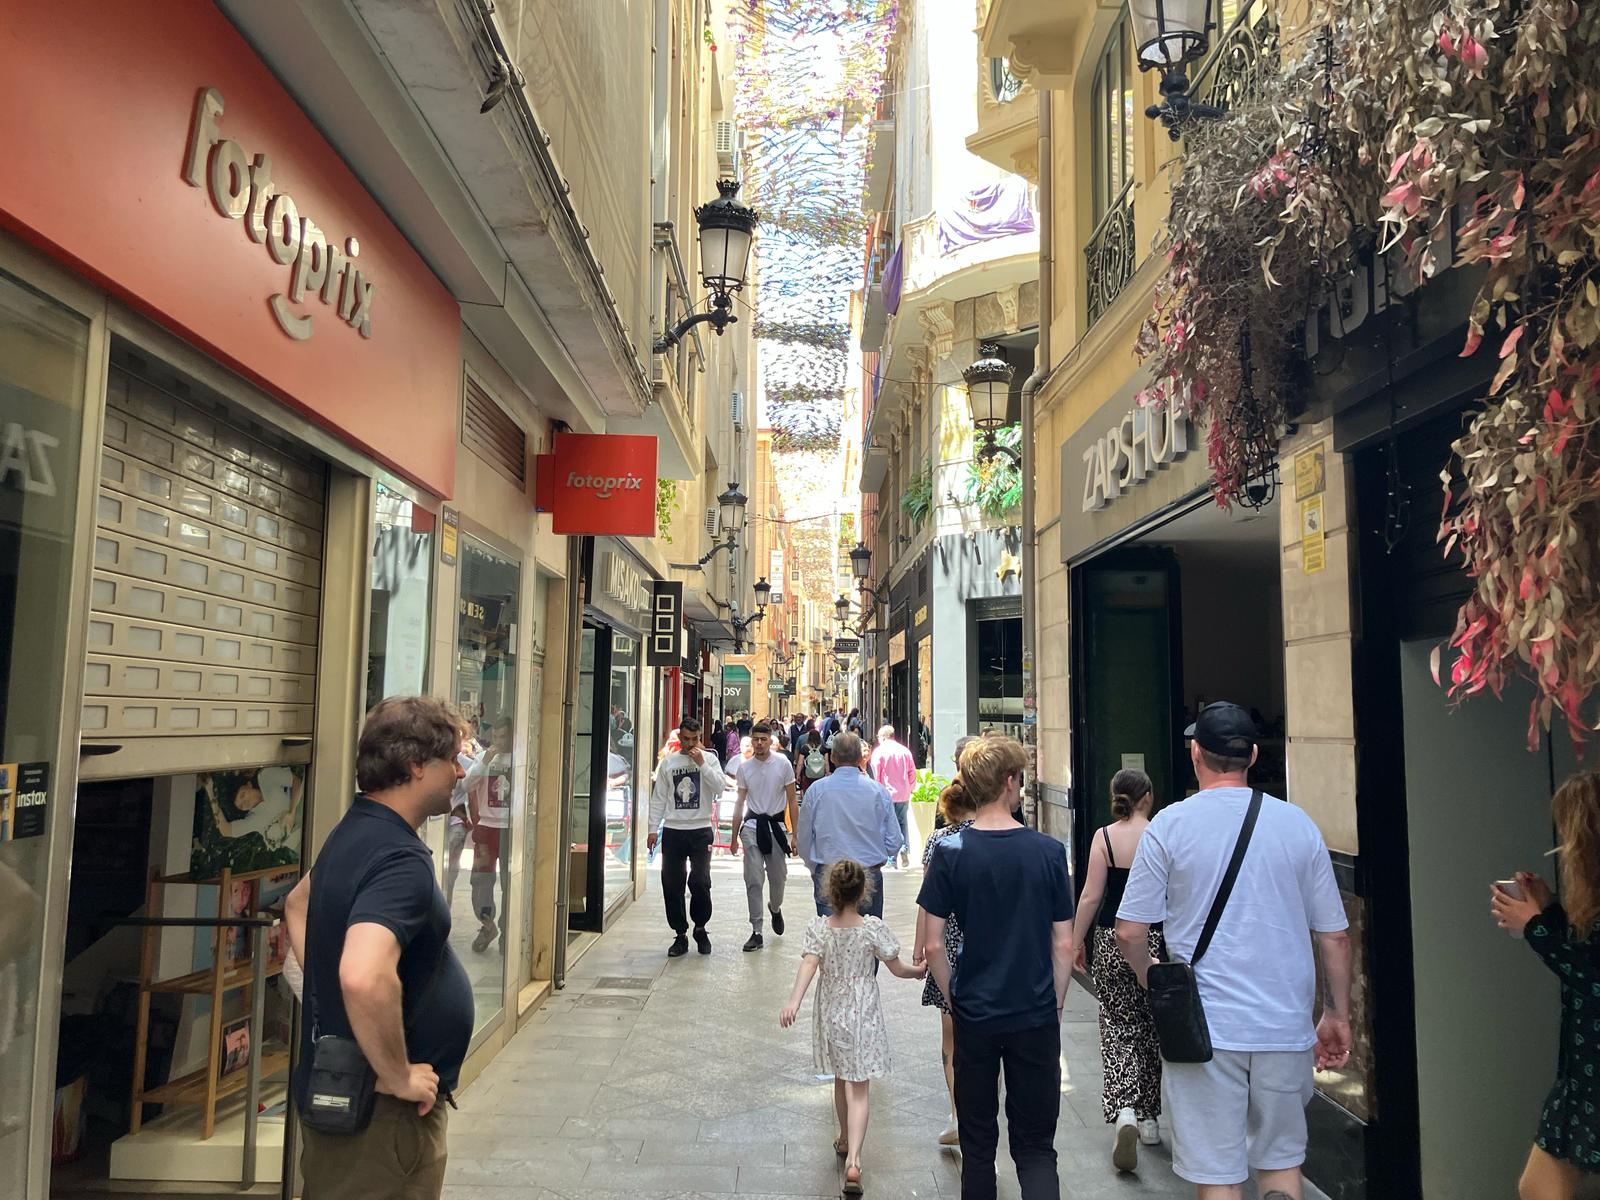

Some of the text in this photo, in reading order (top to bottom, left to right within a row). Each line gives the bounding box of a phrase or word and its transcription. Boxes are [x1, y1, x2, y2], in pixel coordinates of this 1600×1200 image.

[181, 86, 375, 339] fotoprix
[566, 472, 642, 493] fotoprix
[607, 552, 640, 612] MISAKO
[16, 789, 47, 808] instax
